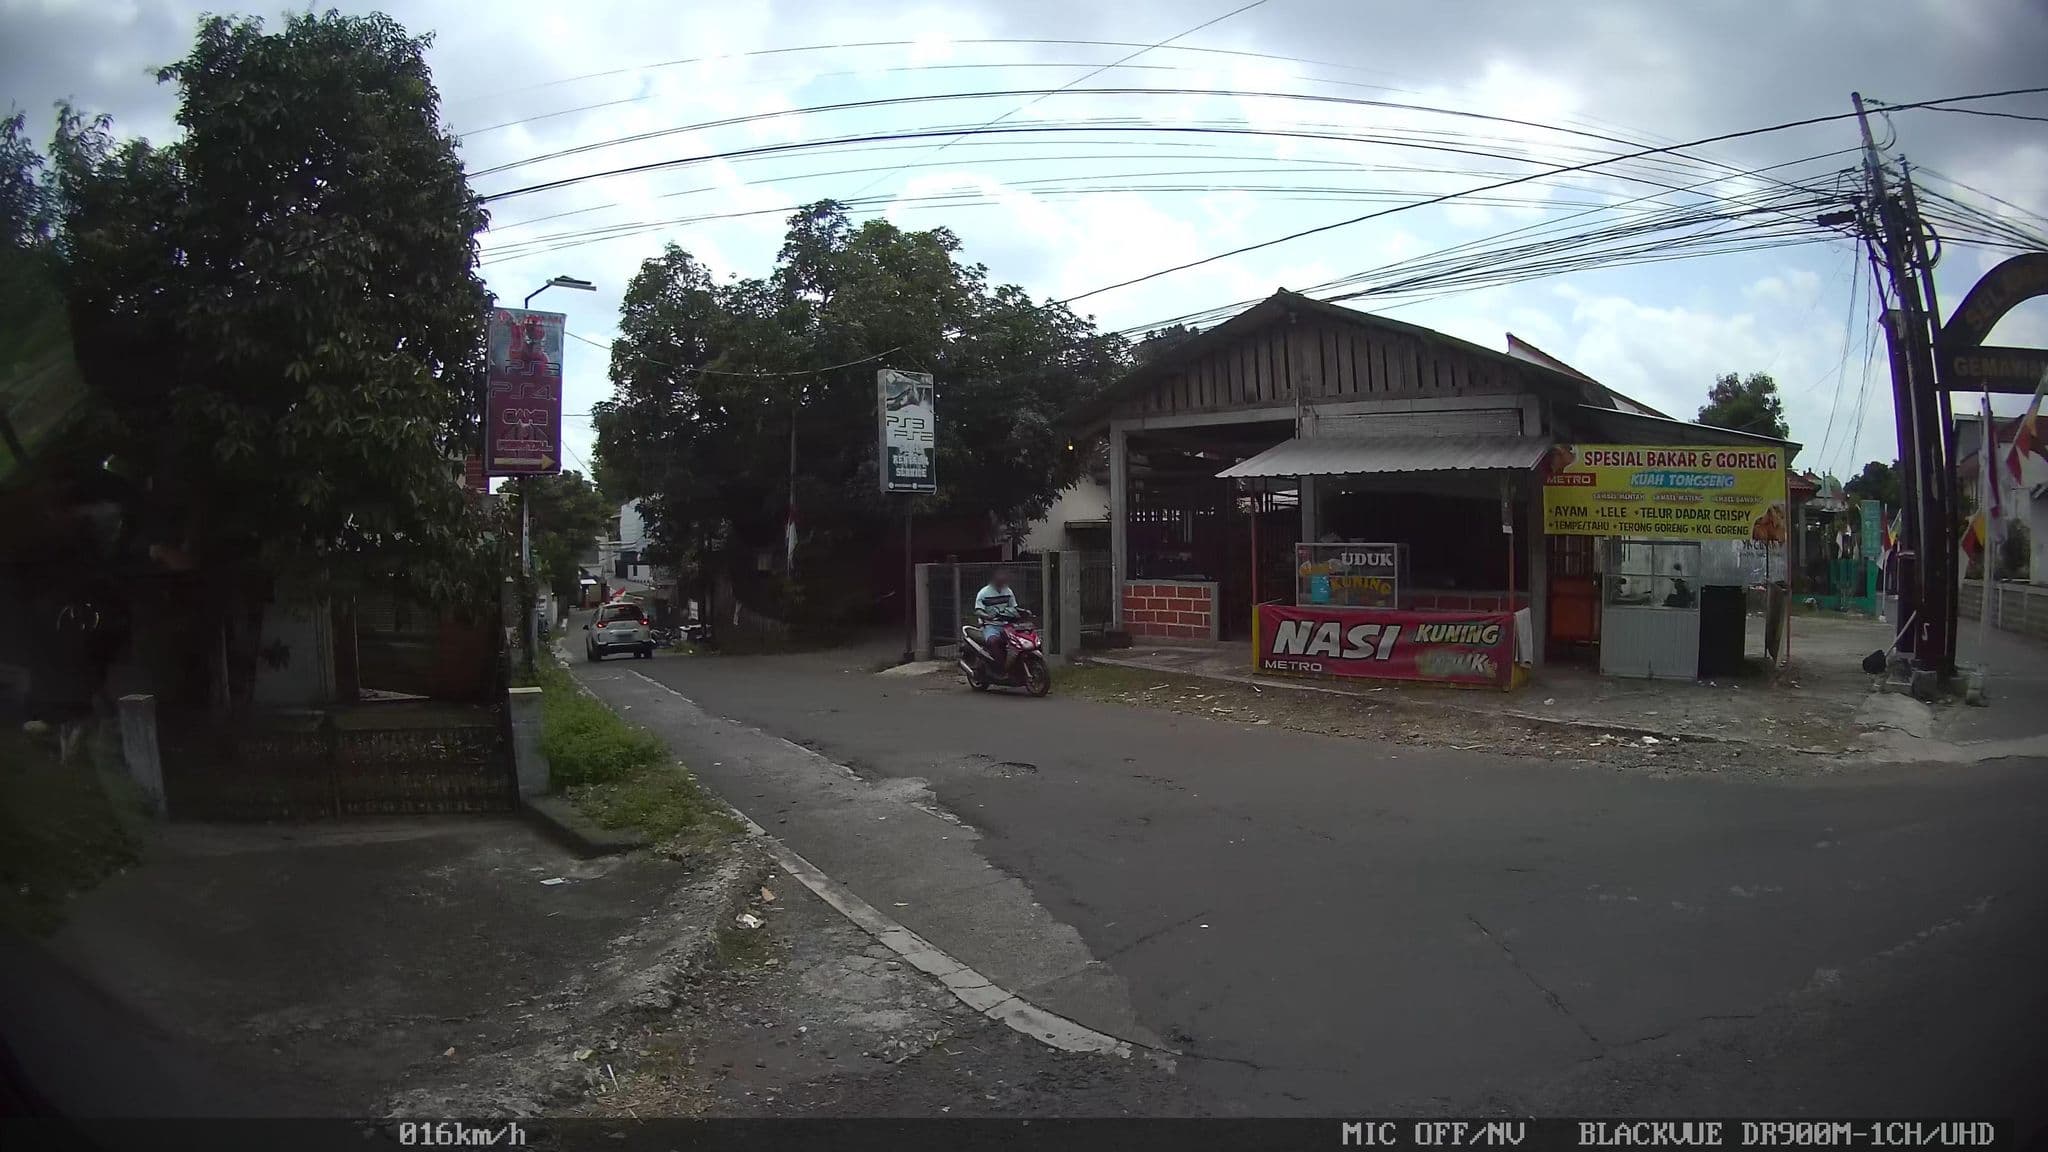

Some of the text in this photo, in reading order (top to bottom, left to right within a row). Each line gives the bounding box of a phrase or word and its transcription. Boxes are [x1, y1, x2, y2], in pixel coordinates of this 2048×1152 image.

[491, 381, 552, 400] PS4
[886, 415, 925, 429] PS3
[1584, 451, 1777, 470] SPESIAL BAKAR & GORENG
[1546, 475, 1591, 484] METRO
[1631, 473, 1735, 487] KUAH TONGSENG
[1554, 506, 1751, 522] AYAM LELE TELUR DADAR CRISPY
[1554, 521, 1749, 536] TEMPE/TAHU TERONG GORENG KOL GORENG
[1340, 552, 1394, 567] UDUK
[1330, 577, 1391, 594] KUNING
[1272, 620, 1402, 660] NASI
[1414, 624, 1501, 645] KUNING
[1265, 659, 1322, 672] METRO
